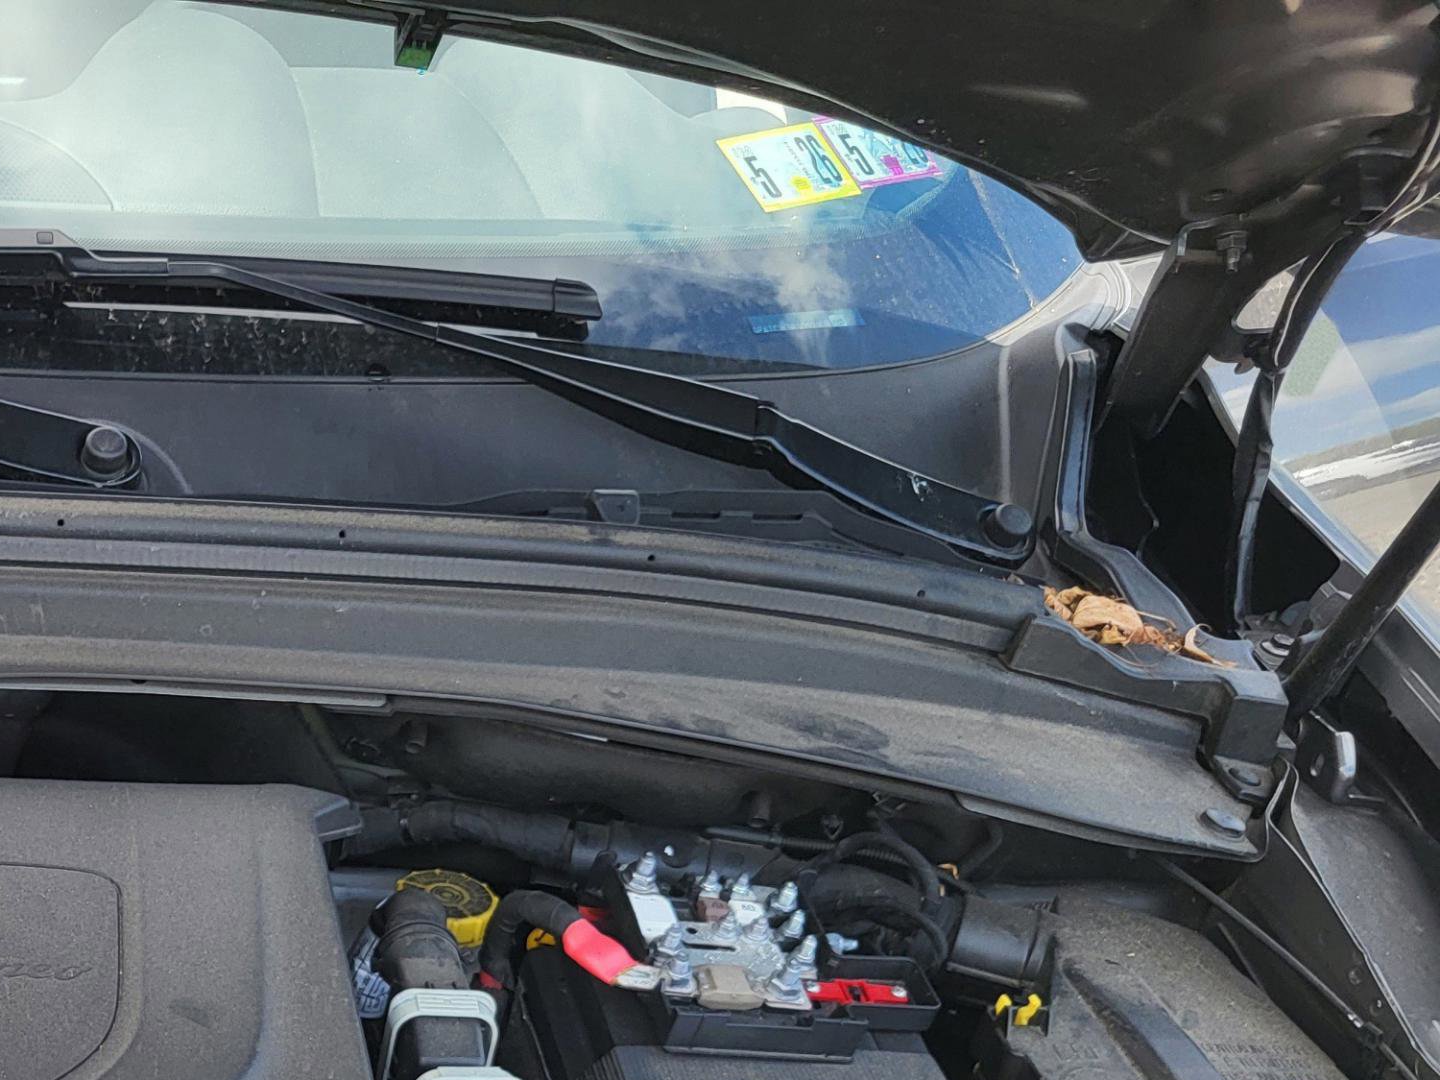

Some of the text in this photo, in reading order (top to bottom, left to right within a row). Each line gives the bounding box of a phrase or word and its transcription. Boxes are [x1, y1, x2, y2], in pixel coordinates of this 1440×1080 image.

[744, 156, 782, 198] 5
[794, 134, 842, 184] 26
[838, 133, 875, 176] 5
